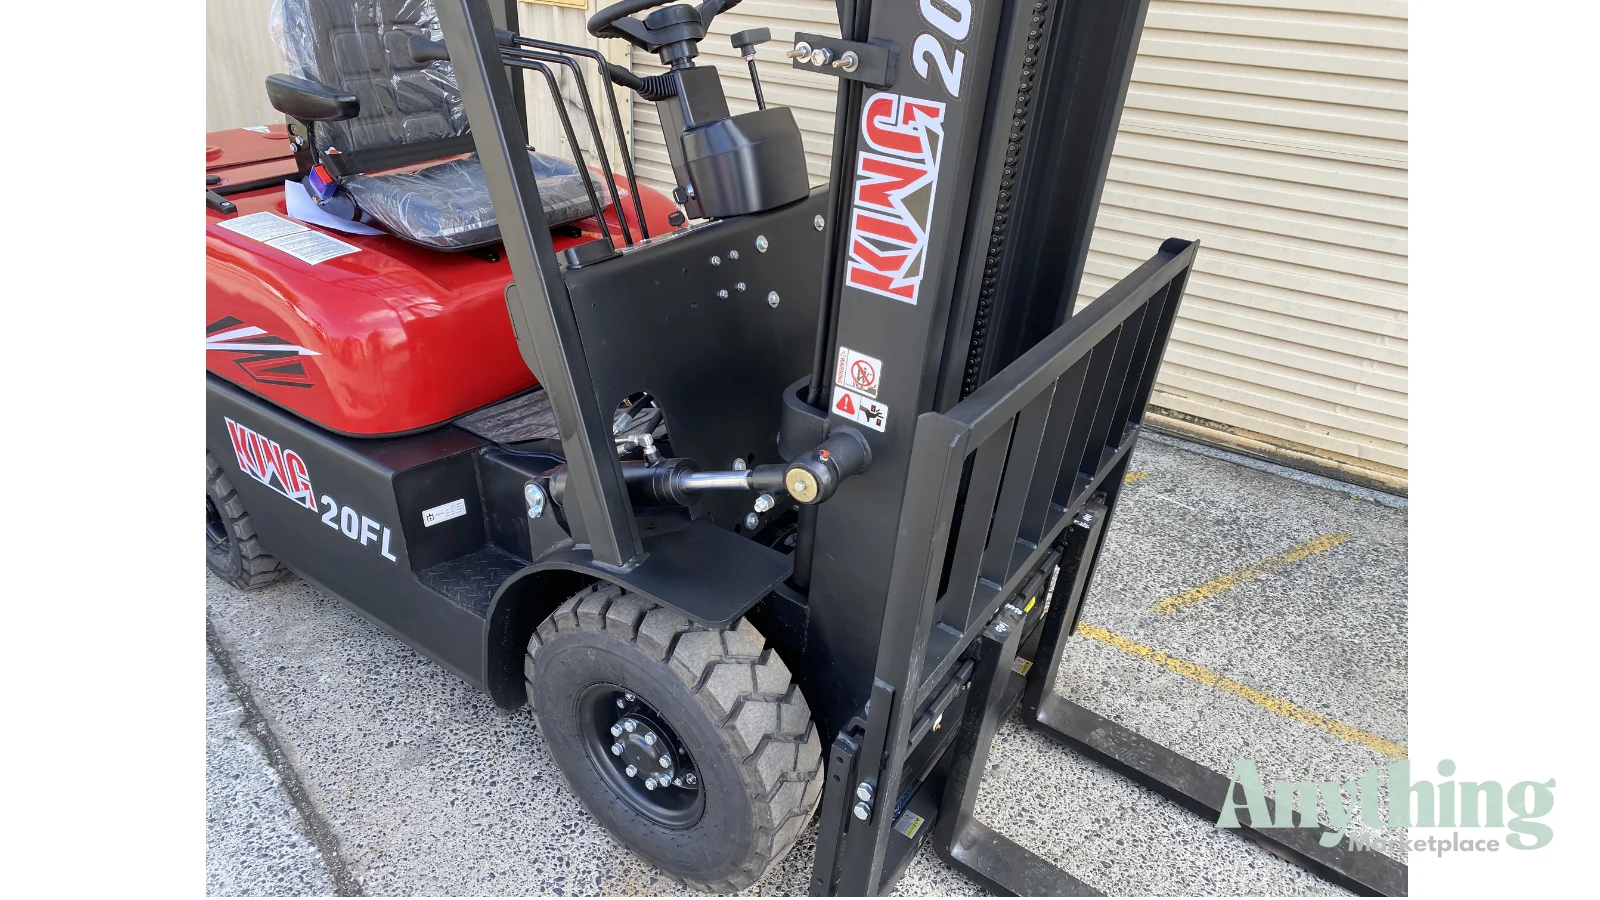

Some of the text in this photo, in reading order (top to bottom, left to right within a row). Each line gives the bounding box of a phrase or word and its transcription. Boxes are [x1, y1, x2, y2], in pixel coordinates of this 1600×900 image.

[846, 92, 946, 305] KING
[837, 357, 846, 384] WARNING
[224, 416, 397, 563] KING 20FL
